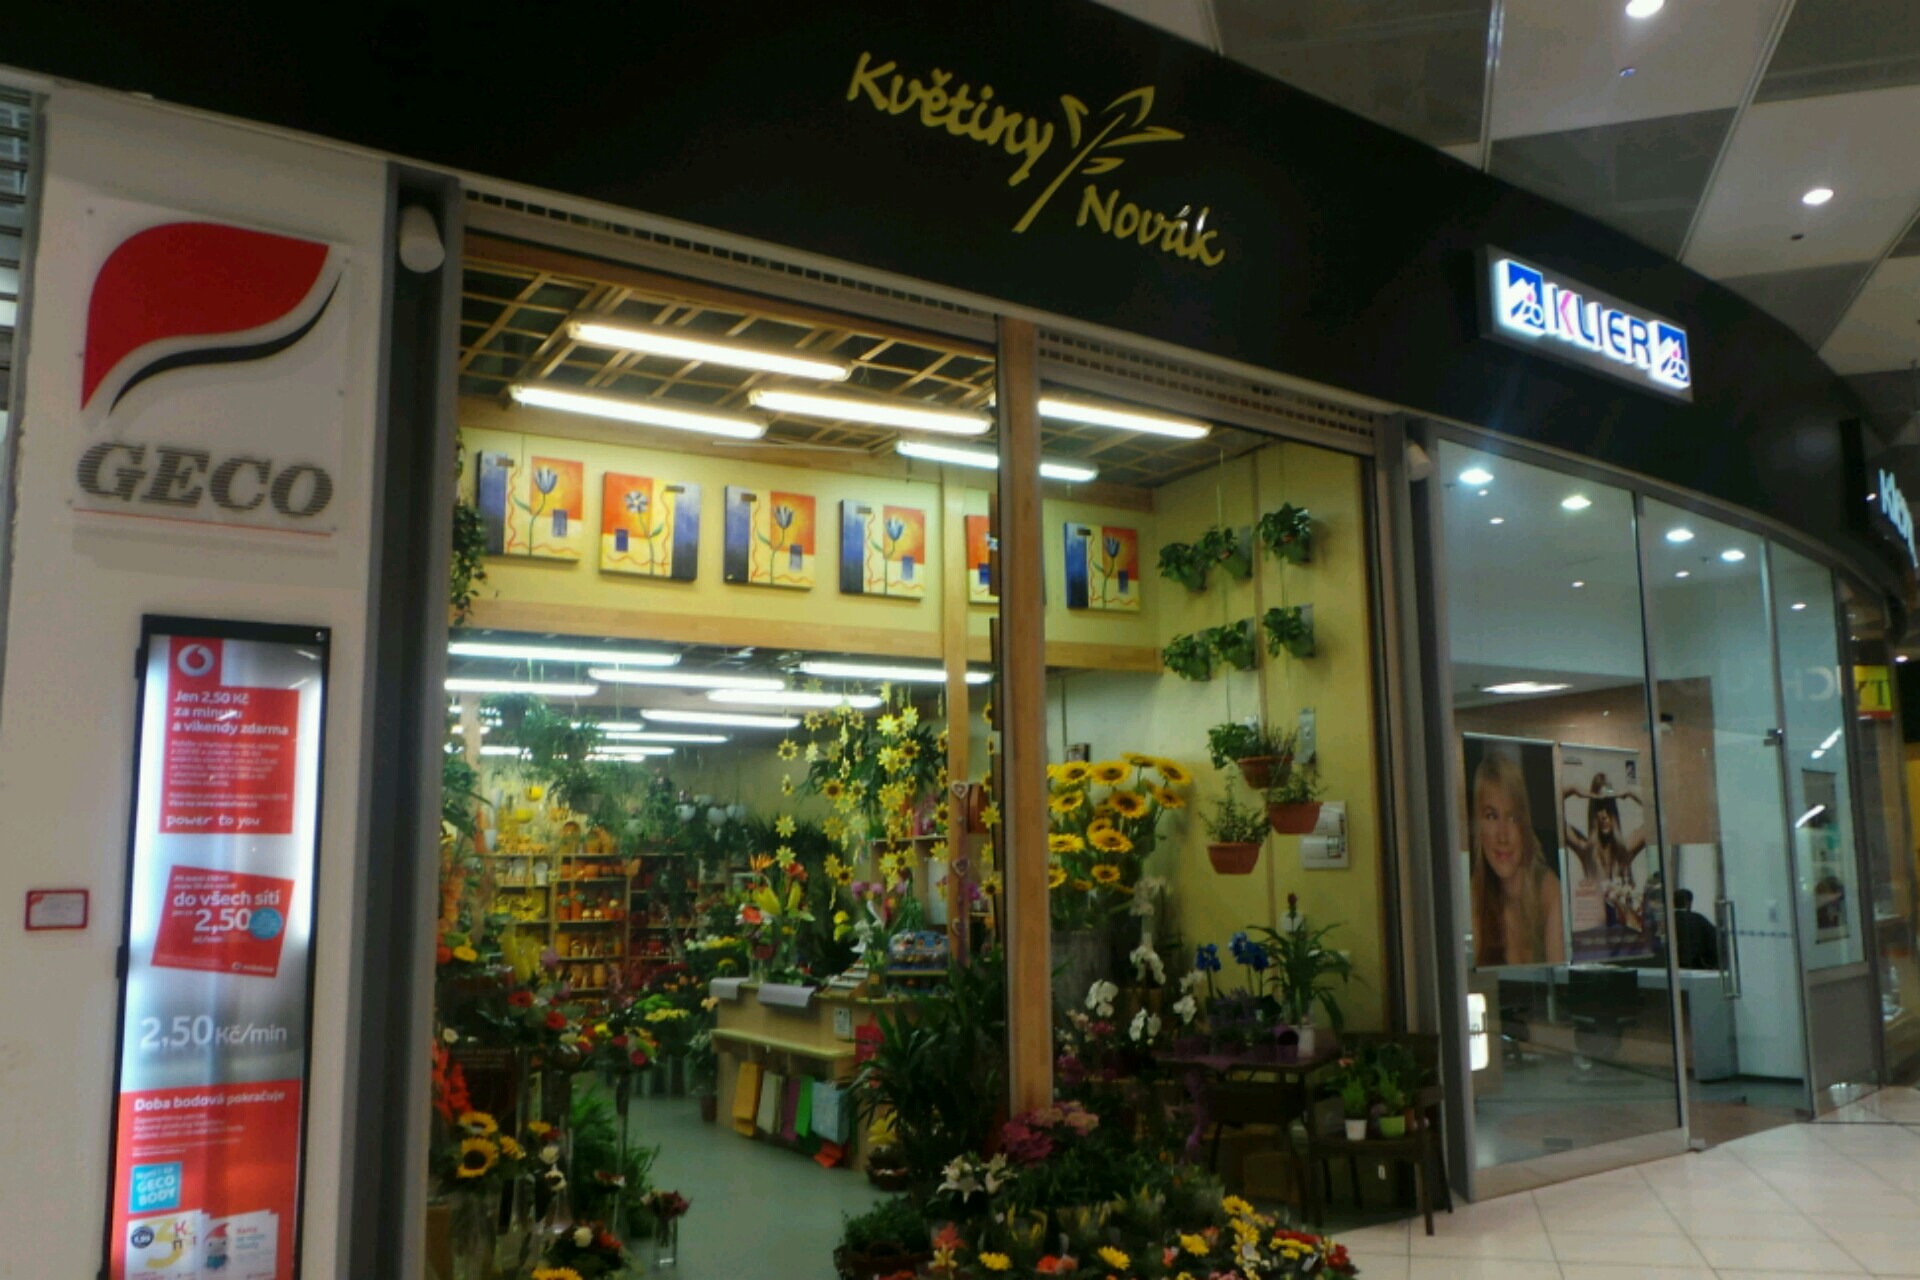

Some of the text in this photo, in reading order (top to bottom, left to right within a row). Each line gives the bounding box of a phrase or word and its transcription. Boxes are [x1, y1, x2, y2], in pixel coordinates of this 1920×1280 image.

[847, 51, 1054, 186] Květiny
[1076, 185, 1224, 267] Novák
[1546, 283, 1651, 369] KLIER
[76, 441, 333, 518] GECO
[241, 722, 289, 735] zdarma
[166, 814, 260, 830] power to you
[173, 891, 196, 907] do
[200, 890, 250, 906] všech
[194, 908, 252, 935] 2,50
[139, 1014, 287, 1048] 2,50 Kč/min
[134, 1098, 170, 1112] Doba
